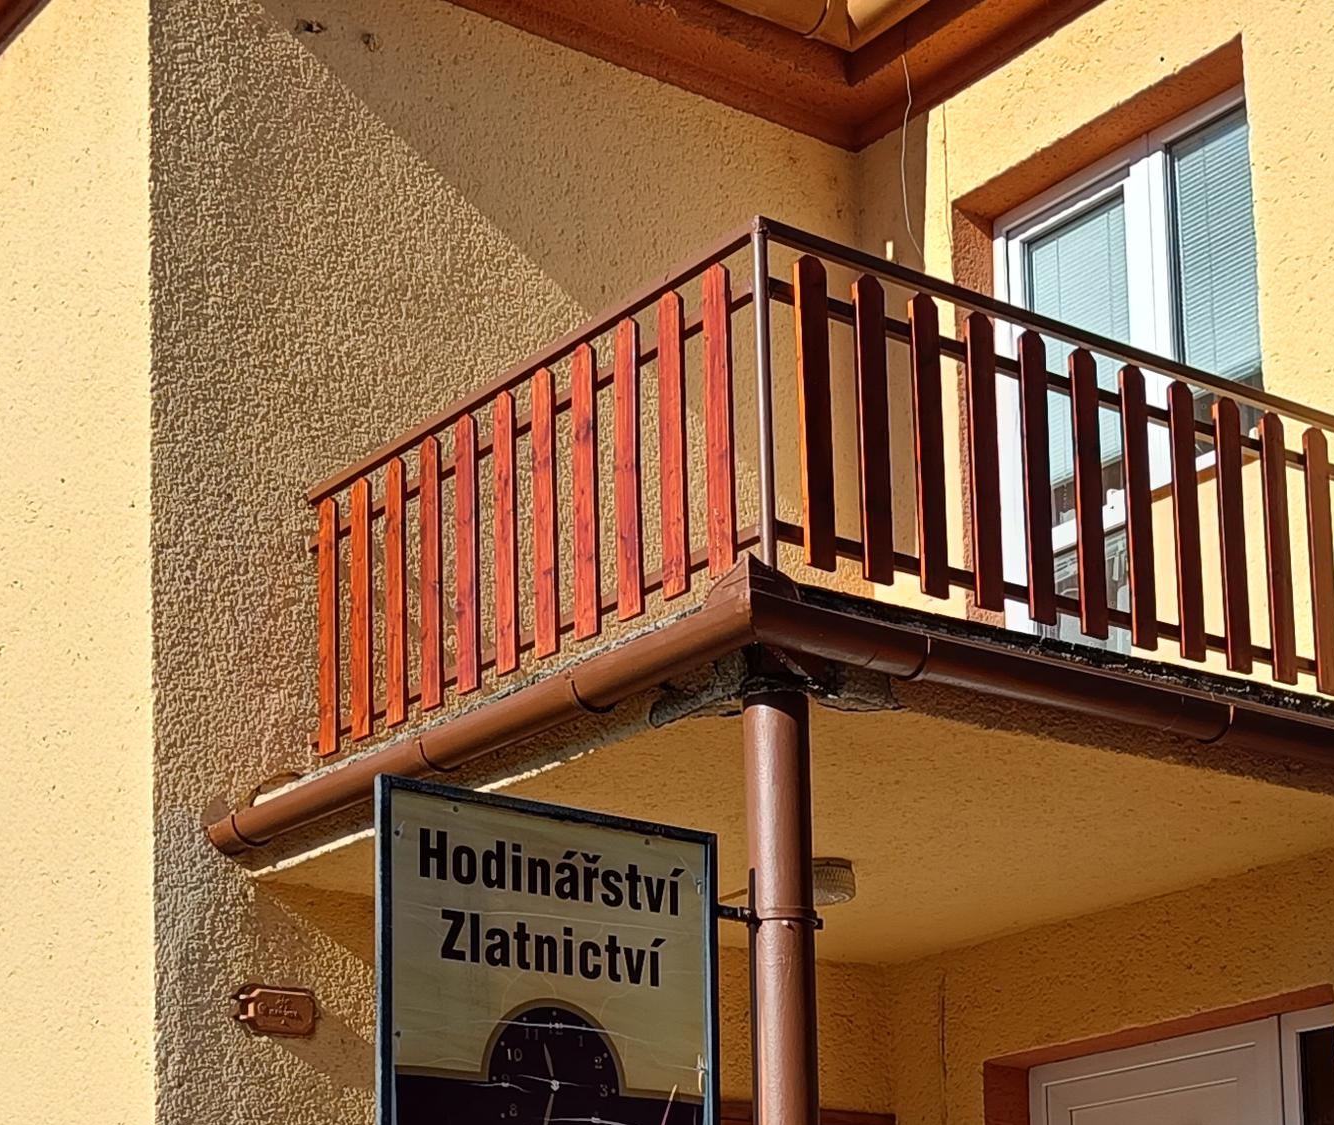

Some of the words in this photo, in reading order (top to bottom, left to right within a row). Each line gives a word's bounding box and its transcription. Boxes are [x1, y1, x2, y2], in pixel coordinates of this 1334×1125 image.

[419, 827, 684, 916] Hodinářství
[440, 909, 665, 987] Zlatnictví
[524, 1027, 539, 1040] 11
[578, 1035, 584, 1047] 1
[507, 1048, 523, 1062] 10
[594, 1056, 603, 1069] 2
[600, 1084, 608, 1097] 3
[509, 1104, 518, 1117] 8
